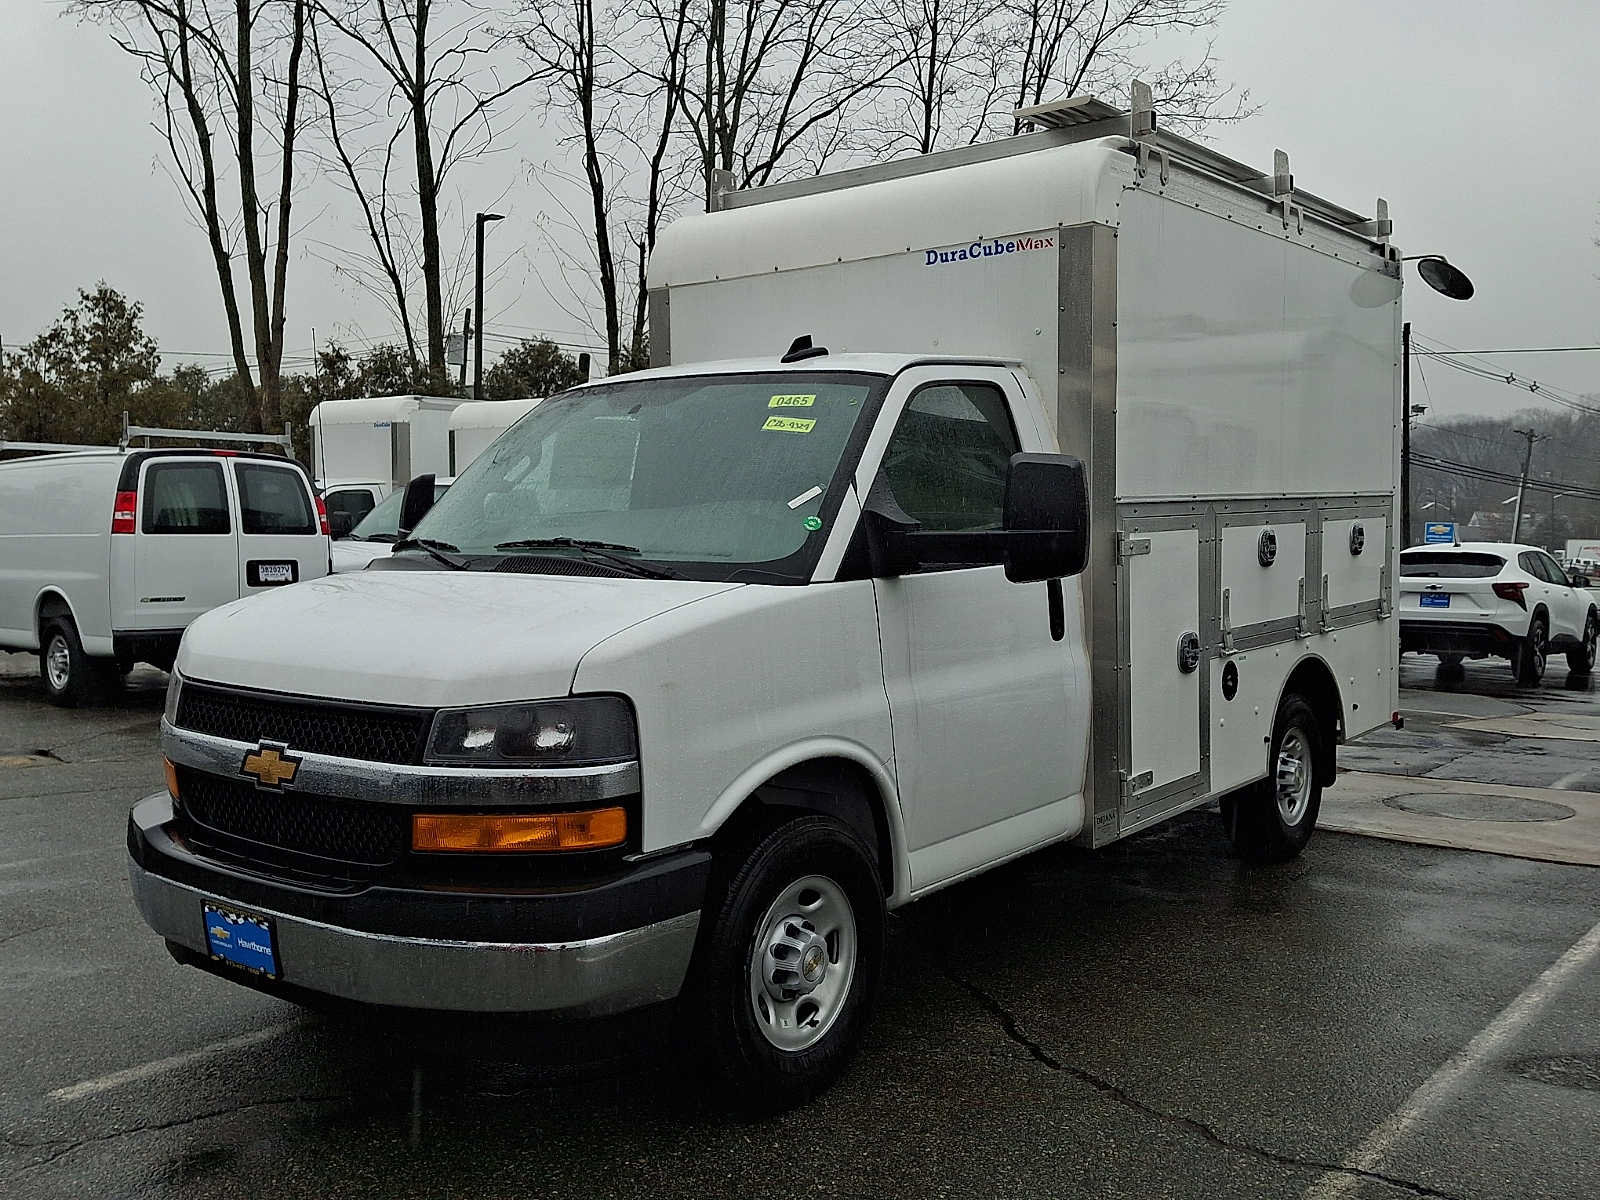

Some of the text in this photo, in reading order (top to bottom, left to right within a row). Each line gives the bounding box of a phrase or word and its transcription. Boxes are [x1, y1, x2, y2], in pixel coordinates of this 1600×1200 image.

[925, 237, 1054, 265] DuraCubeMax
[776, 396, 809, 406] 0465
[237, 937, 272, 956] Hawthorne
